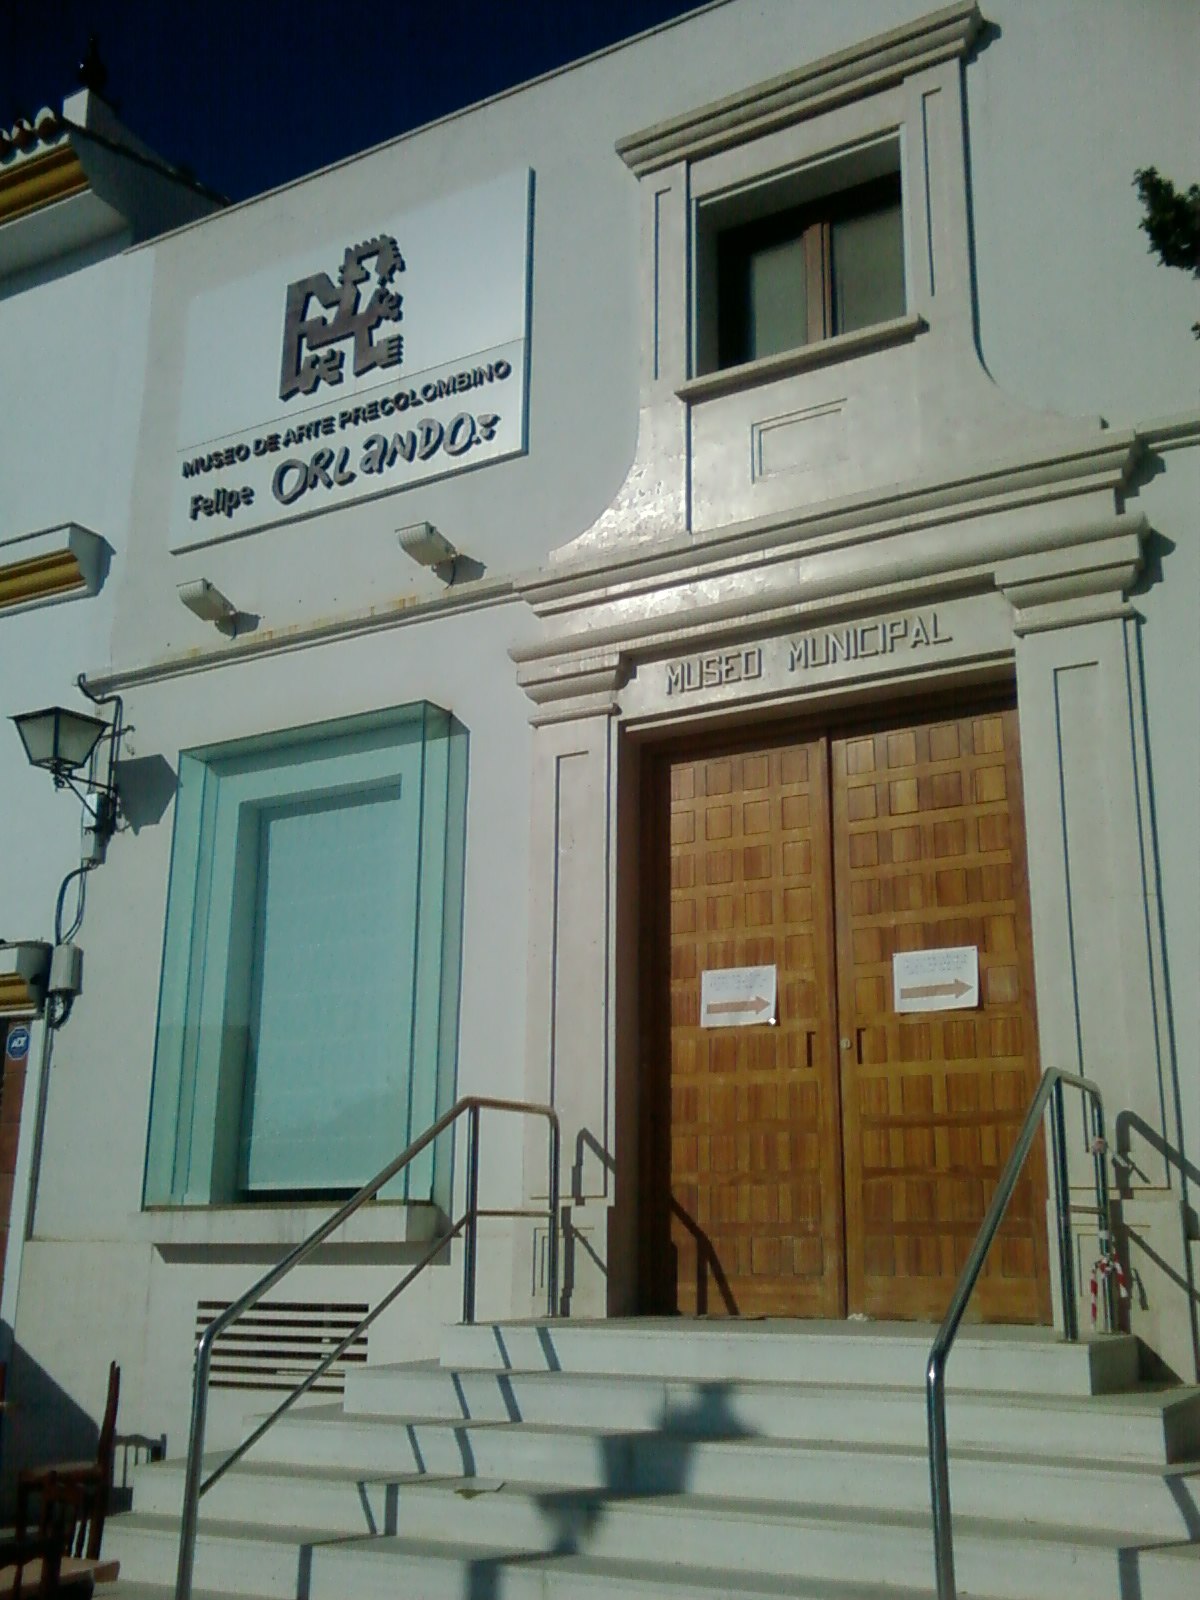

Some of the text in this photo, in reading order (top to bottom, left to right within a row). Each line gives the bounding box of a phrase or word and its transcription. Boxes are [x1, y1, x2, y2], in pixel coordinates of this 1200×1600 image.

[181, 359, 512, 478] MUSEO DE ARTE PRECOLOMBINO
[189, 486, 255, 520] Felipe
[666, 612, 953, 695] MUSEO MUNICIPAL
